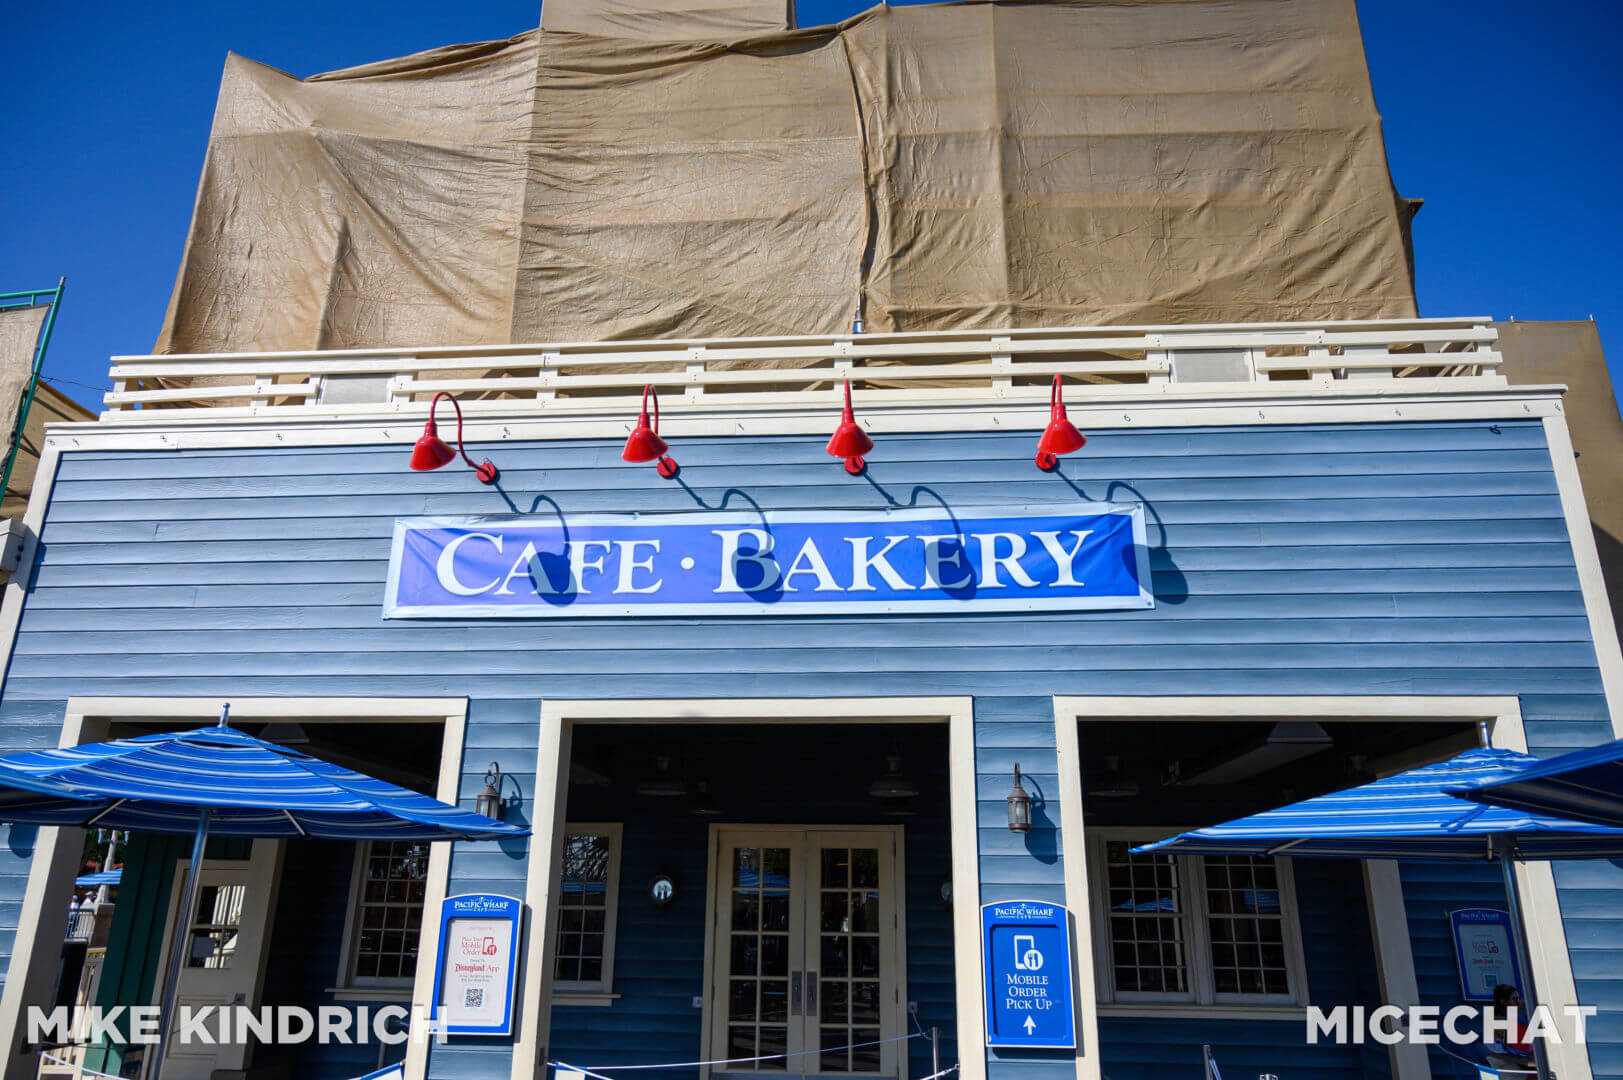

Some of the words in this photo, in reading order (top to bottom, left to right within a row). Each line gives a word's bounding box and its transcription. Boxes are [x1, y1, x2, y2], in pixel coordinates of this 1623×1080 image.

[436, 533, 663, 596] CAFE
[712, 529, 1095, 594] BAKERY
[454, 901, 482, 909] PACIFIC
[483, 901, 509, 909] WHARF
[994, 908, 1025, 916] PACIFIC
[1026, 908, 1054, 916] WHARF
[1006, 973, 1049, 985] MOBILE
[1008, 985, 1048, 997] ORDER
[1005, 998, 1033, 1010] PICK
[1035, 998, 1053, 1010] UP
